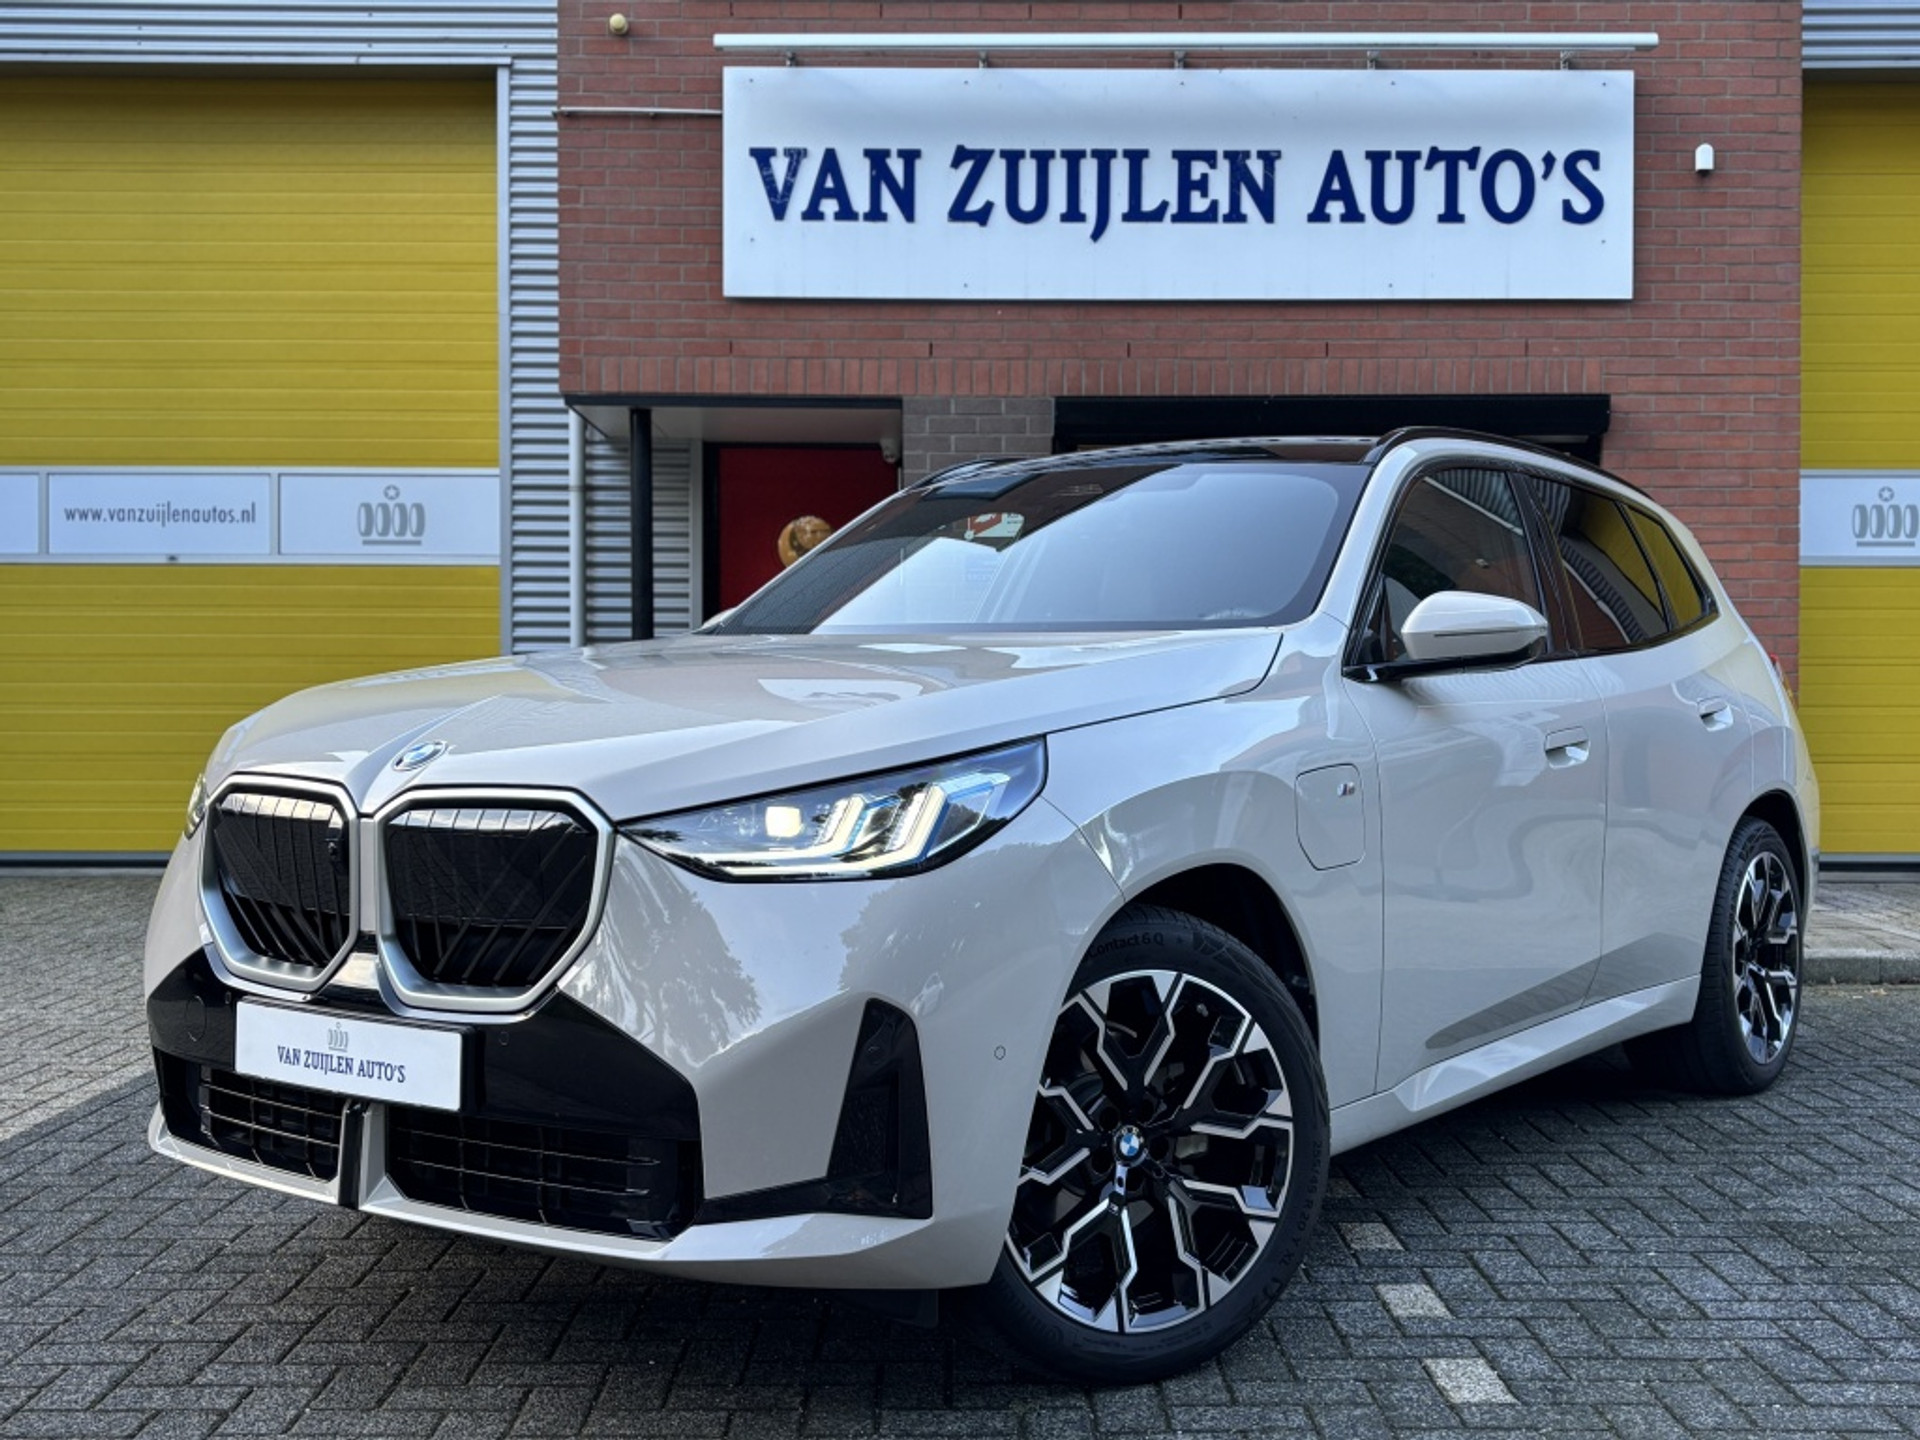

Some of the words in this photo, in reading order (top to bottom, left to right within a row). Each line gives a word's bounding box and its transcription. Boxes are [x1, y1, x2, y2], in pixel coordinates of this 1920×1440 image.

[749, 146, 922, 222] VAN
[949, 144, 1281, 243] ZUIJLEN
[1308, 146, 1604, 226] AUTO'S
[64, 501, 256, 527] www.vanzuijlenautos.nl
[277, 1045, 301, 1066] VAN
[303, 1050, 354, 1075] ZUIJLEN
[356, 1058, 406, 1083] AUTO'S
